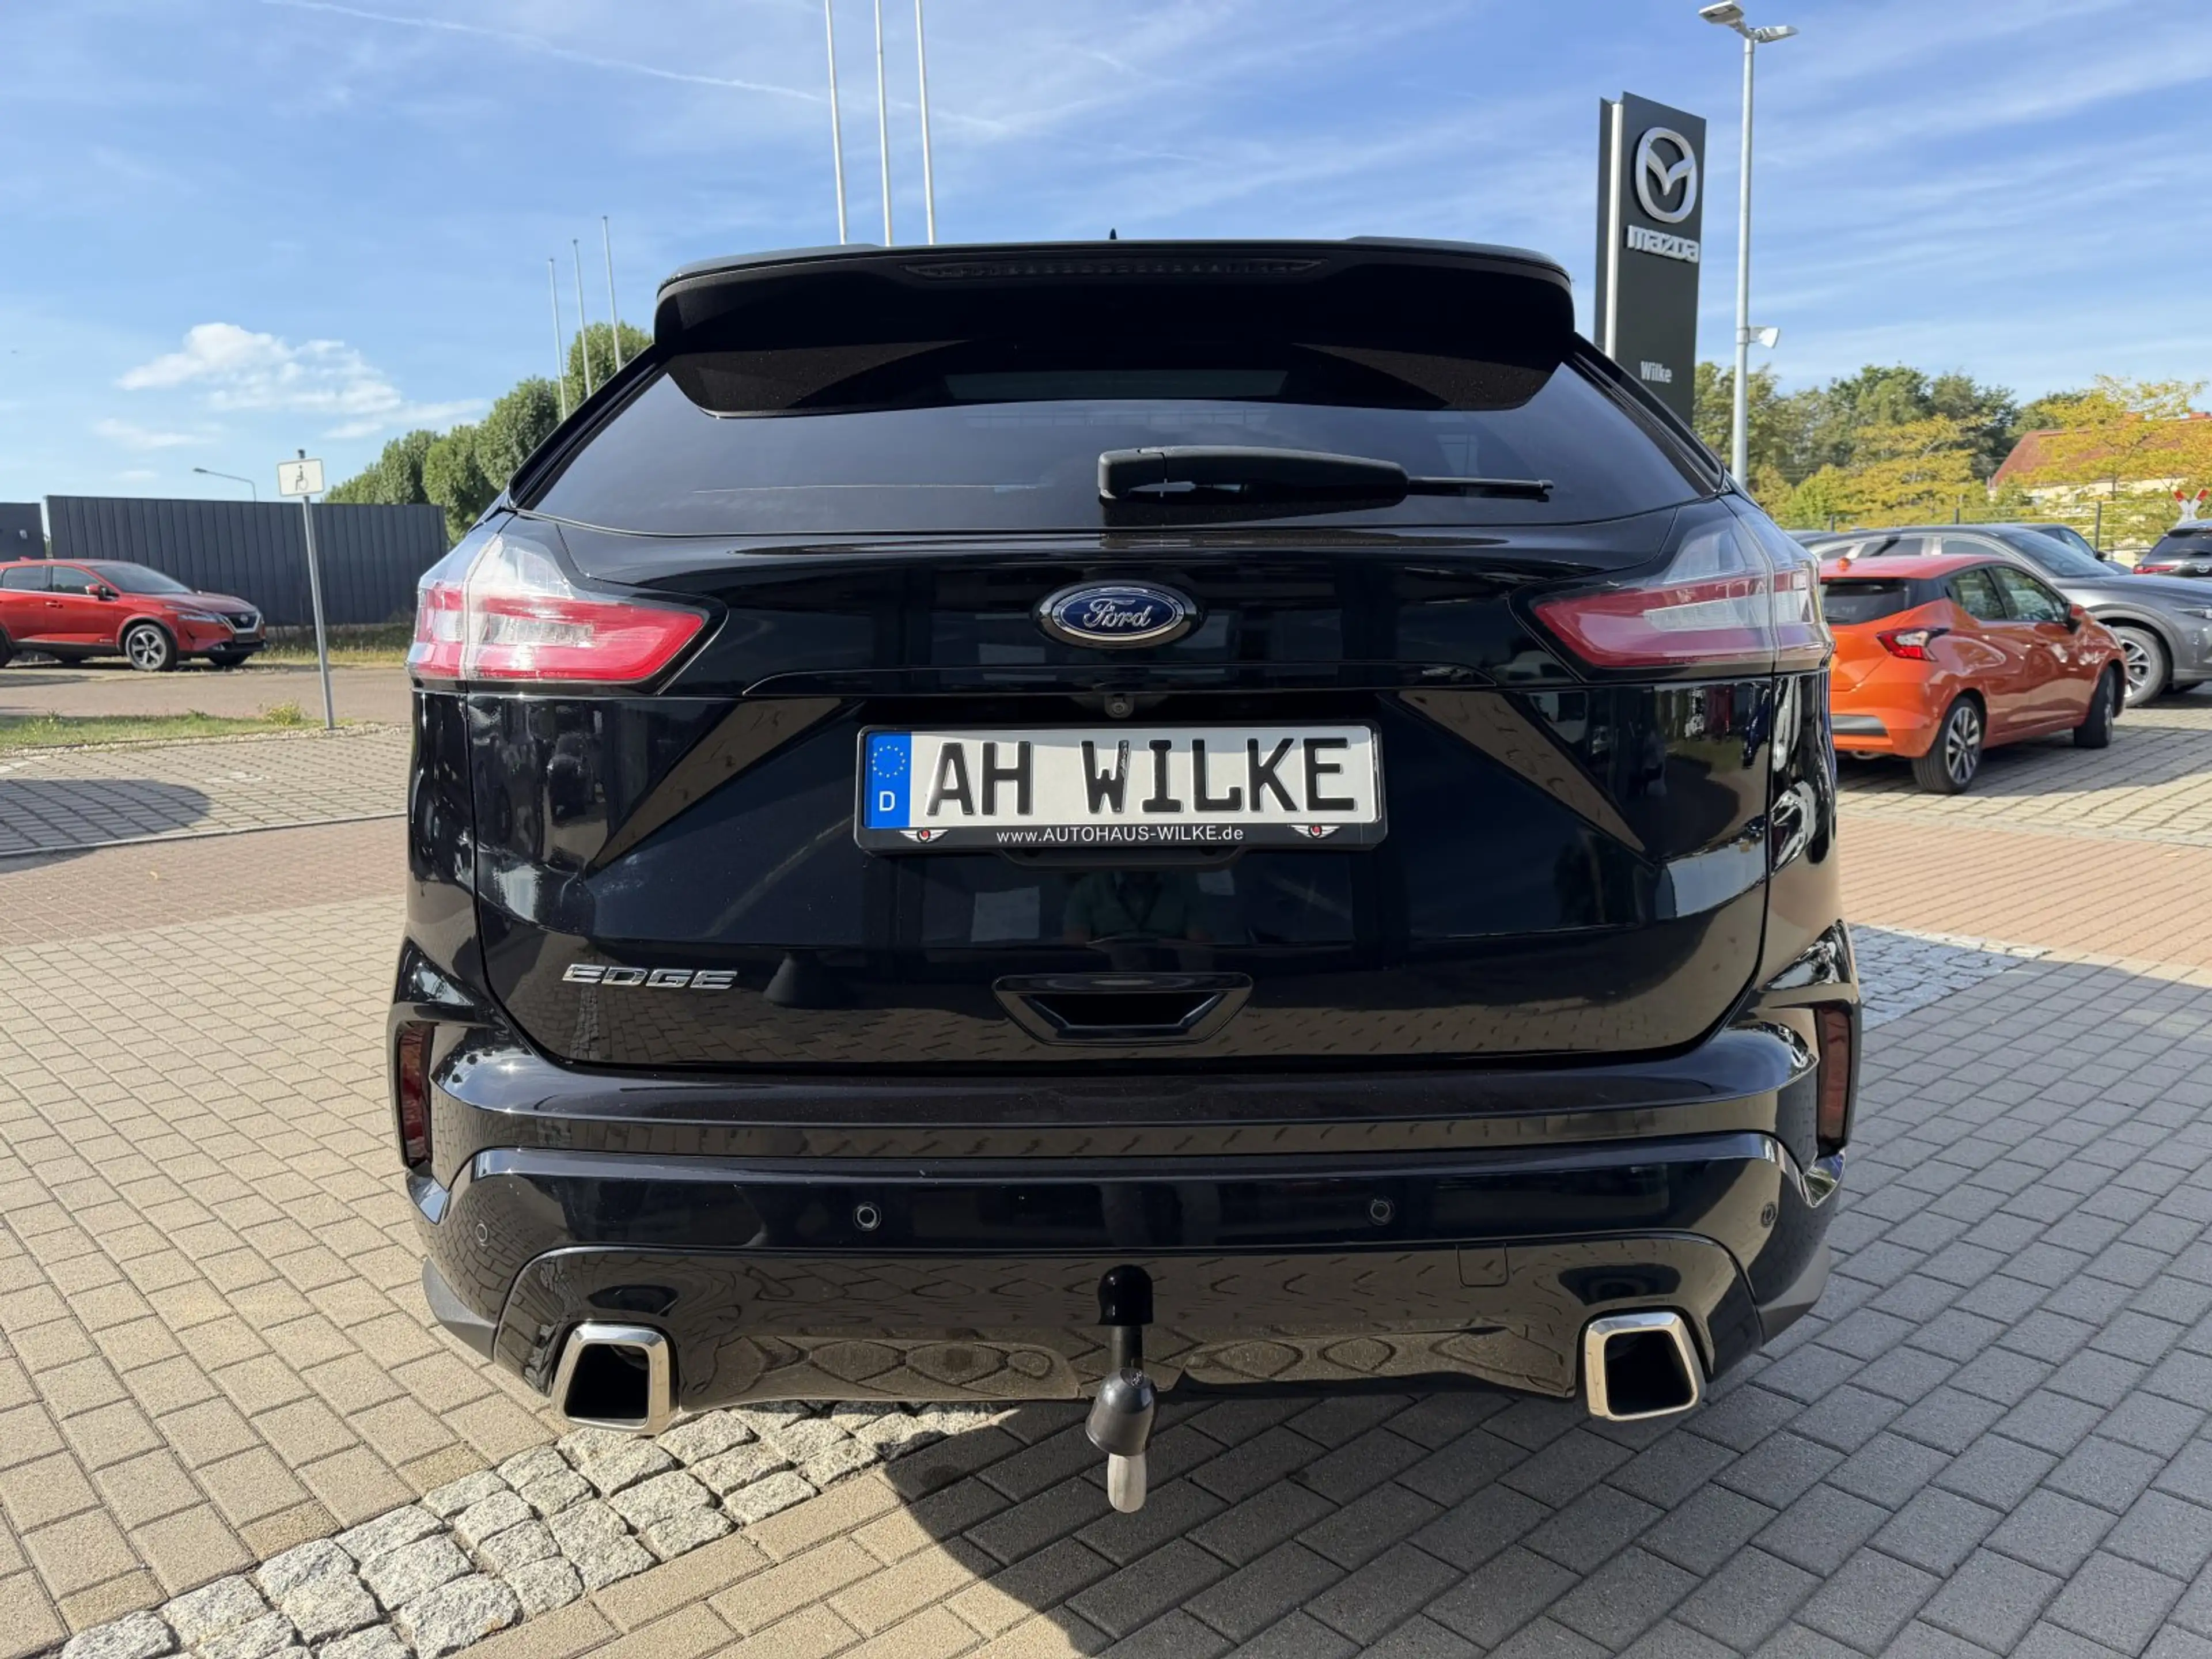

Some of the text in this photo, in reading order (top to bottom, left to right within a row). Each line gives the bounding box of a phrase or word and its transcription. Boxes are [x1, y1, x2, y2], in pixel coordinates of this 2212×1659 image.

[1627, 225, 1699, 263] mazda
[1641, 361, 1672, 384] Wilke
[1083, 599, 1153, 628] Ford
[925, 738, 1355, 816] AH WILKE
[879, 791, 895, 812] D
[996, 825, 1244, 843] www.AUTOHAUS-WILKE.de
[562, 964, 738, 989] EDGE
